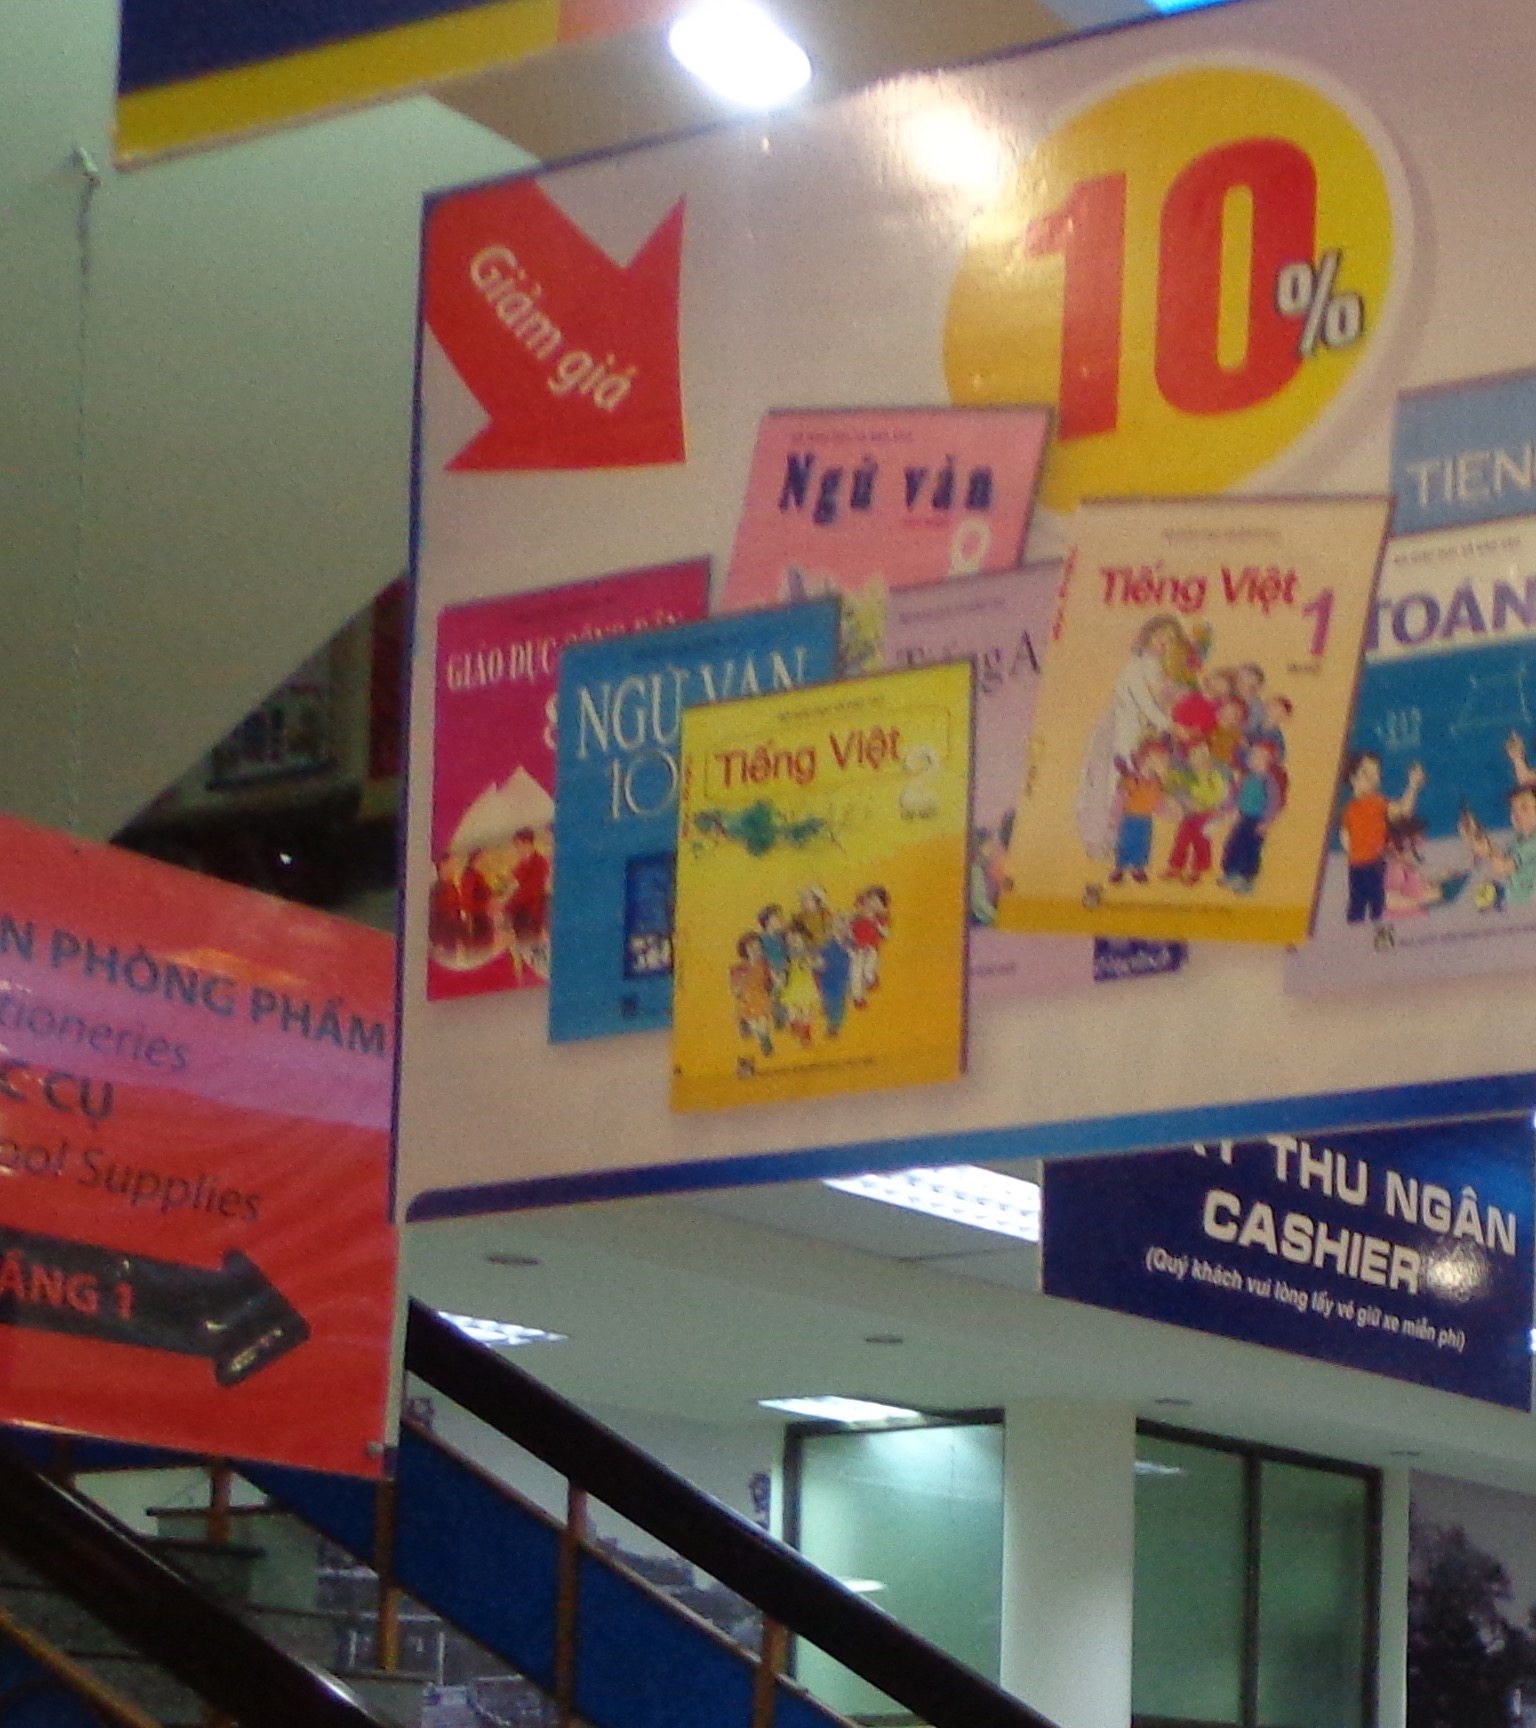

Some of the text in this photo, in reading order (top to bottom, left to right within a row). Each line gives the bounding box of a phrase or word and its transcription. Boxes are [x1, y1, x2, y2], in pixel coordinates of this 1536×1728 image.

[469, 244, 638, 414] Giảm giá
[1100, 558, 1298, 615] Tiếng Việt
[713, 722, 901, 791] Tiếng Việt
[78, 1146, 263, 1222] Supplies
[1384, 1170, 1518, 1257] NGÂN
[1202, 1187, 1422, 1297] CASHIER
[1191, 1256, 1243, 1291] khách
[1245, 1275, 1274, 1299] vui
[1273, 1279, 1309, 1312] lòng
[1381, 1312, 1402, 1332] xe
